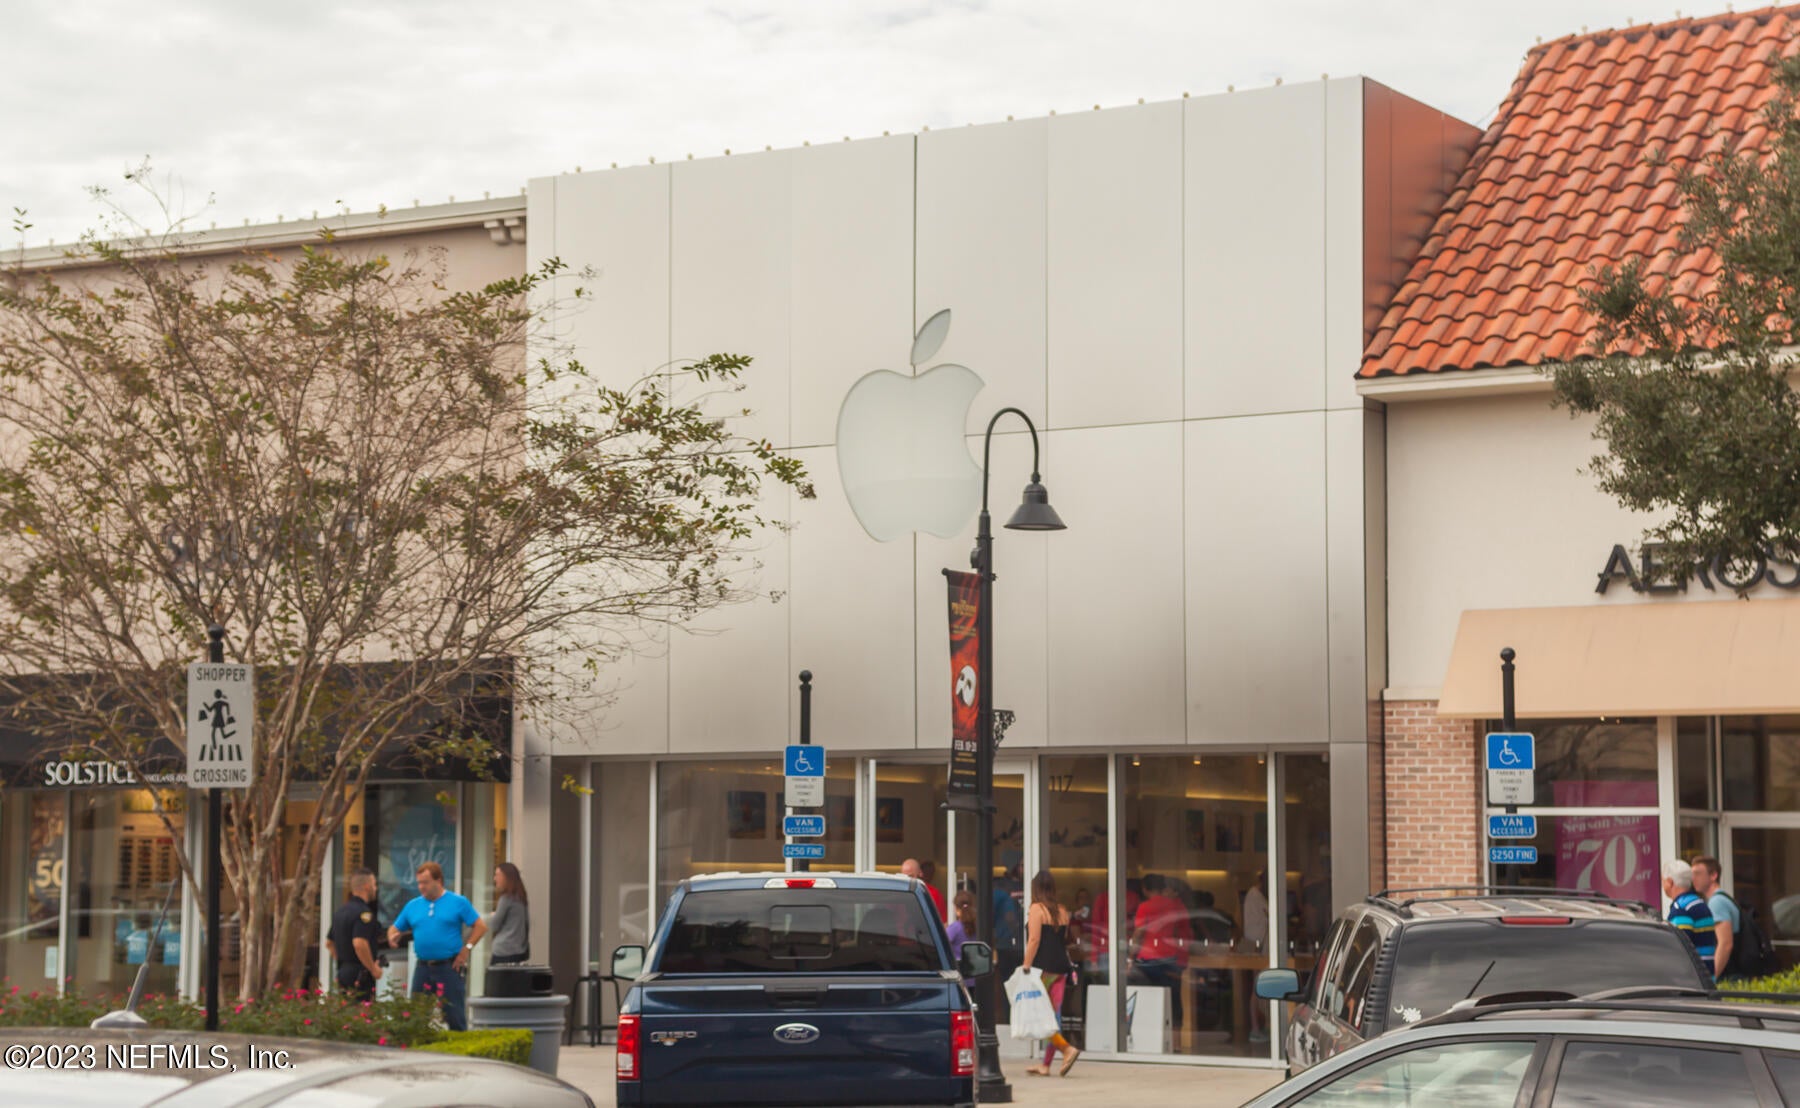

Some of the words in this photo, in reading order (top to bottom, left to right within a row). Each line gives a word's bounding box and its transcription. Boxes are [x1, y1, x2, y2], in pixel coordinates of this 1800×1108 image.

[197, 668, 246, 681] SHOPPER
[193, 768, 247, 783] CROSSING
[1050, 775, 1073, 793] 117
[1502, 818, 1523, 827] VAN
[785, 847, 806, 856] $250
[807, 847, 823, 856] FINE
[1491, 850, 1514, 860] $250
[1516, 850, 1535, 860] FINE
